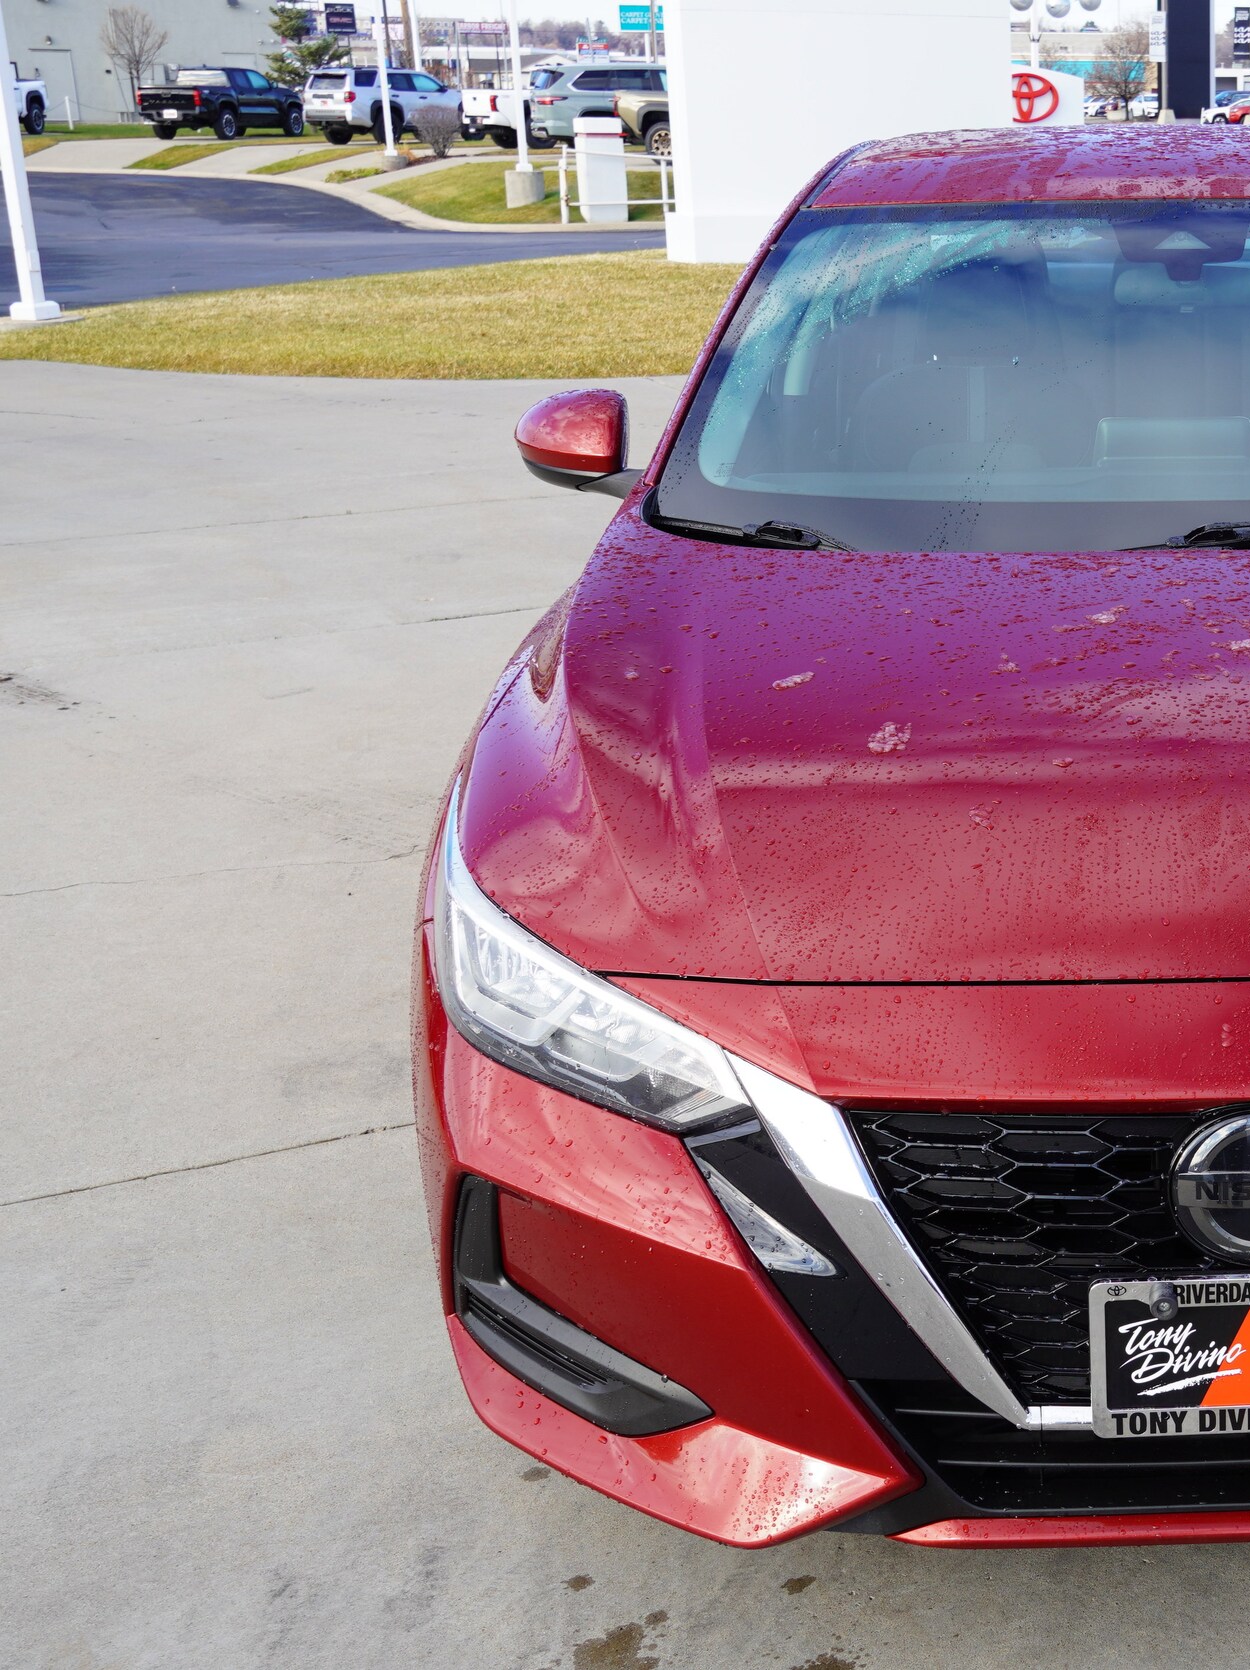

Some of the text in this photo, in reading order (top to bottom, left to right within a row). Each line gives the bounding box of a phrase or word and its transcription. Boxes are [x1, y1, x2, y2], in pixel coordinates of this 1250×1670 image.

[1118, 1317, 1197, 1356] Tony
[1119, 1340, 1247, 1384] Divino
[1111, 1410, 1188, 1436] TONY
